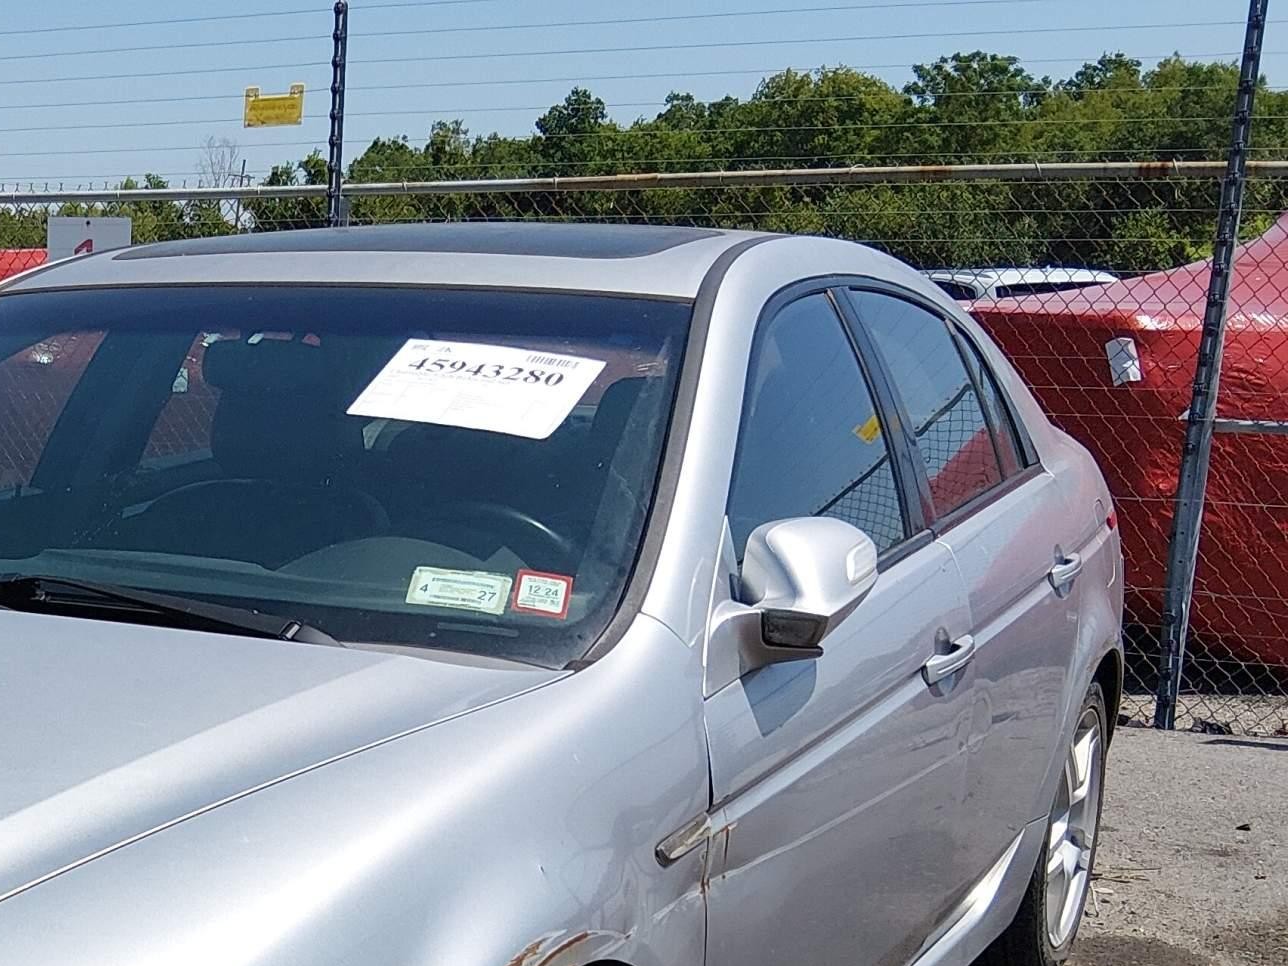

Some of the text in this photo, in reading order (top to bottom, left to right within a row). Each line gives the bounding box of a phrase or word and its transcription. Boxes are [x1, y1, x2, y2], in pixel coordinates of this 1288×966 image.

[407, 356, 565, 387] 45943280
[477, 590, 497, 602] 27
[528, 584, 559, 597] 12 24
